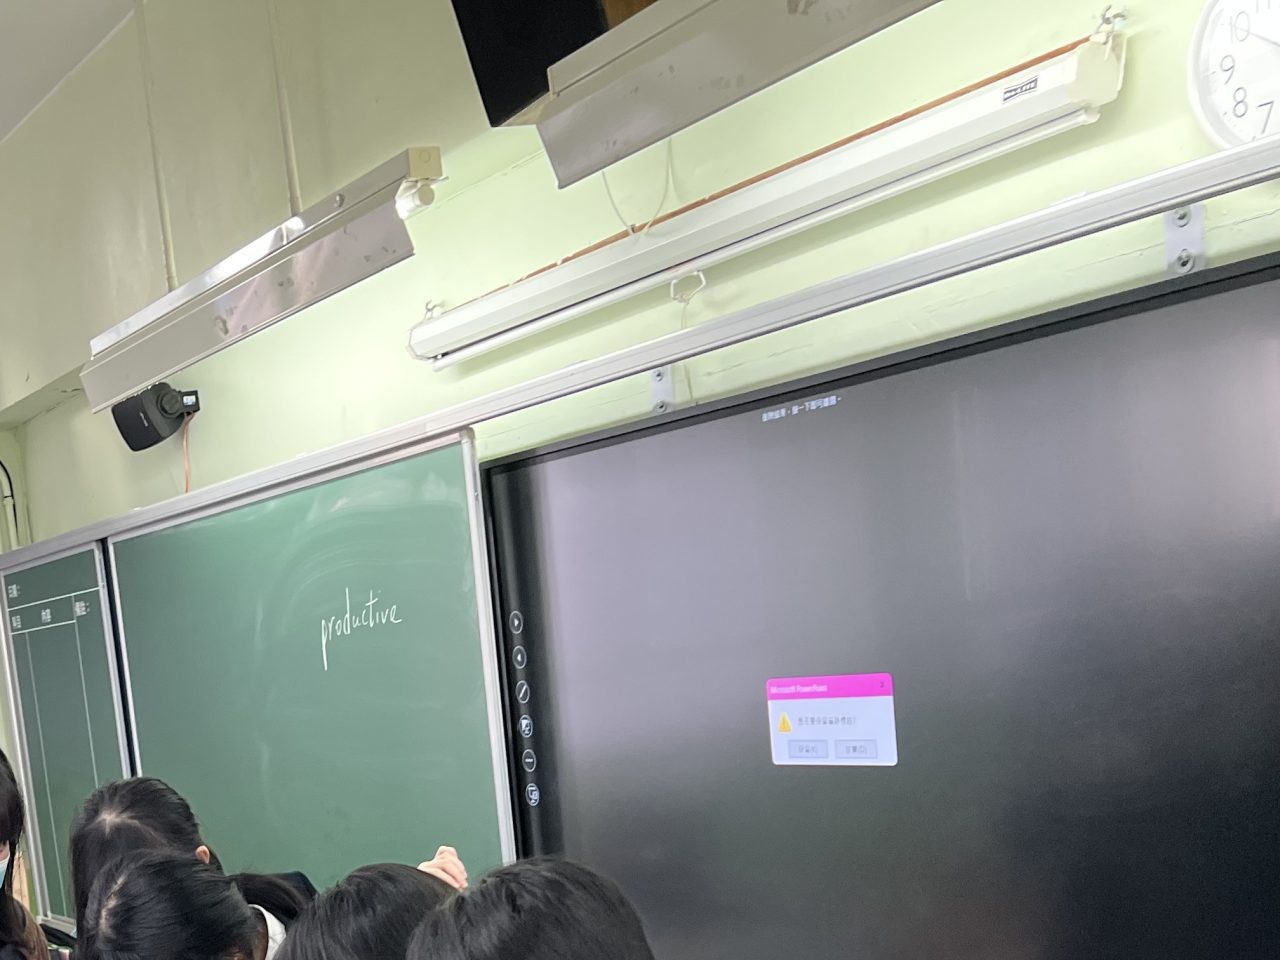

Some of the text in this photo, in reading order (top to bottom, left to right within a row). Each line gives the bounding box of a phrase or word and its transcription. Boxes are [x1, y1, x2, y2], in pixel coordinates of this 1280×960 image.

[1220, 54, 1236, 85] 9
[1233, 86, 1248, 118] 8
[1256, 100, 1274, 134] 7
[321, 587, 403, 671] productive
